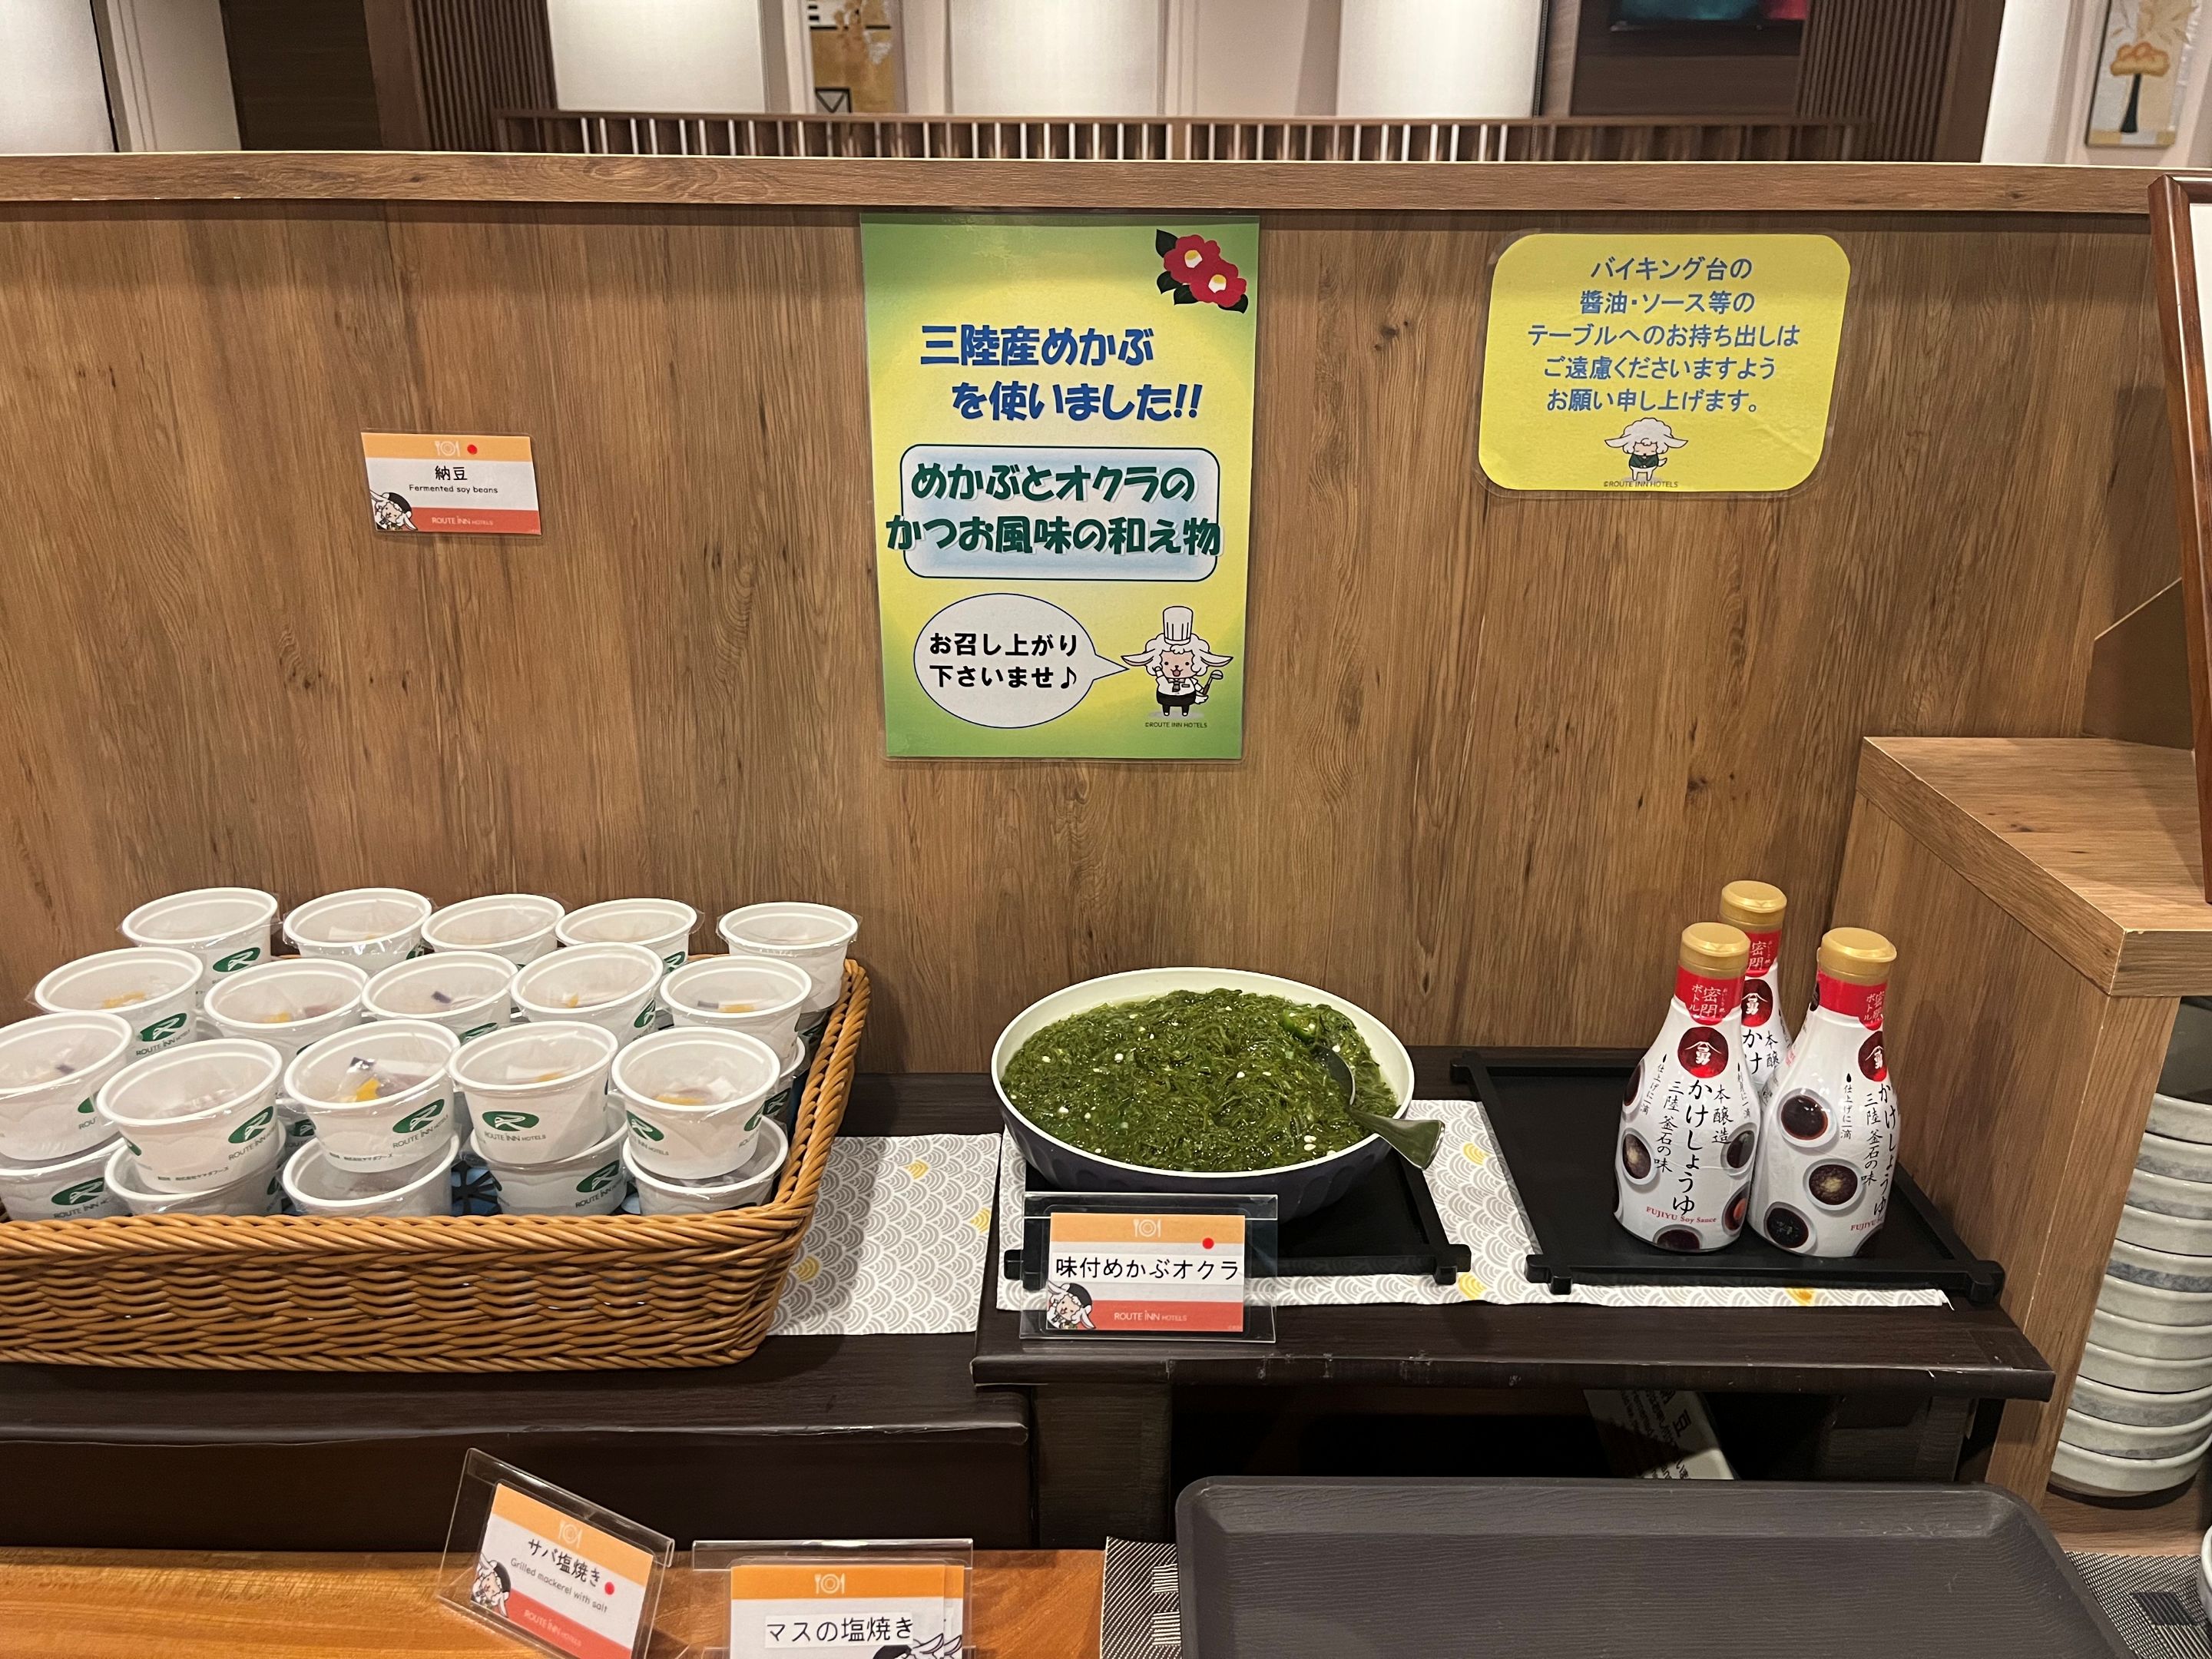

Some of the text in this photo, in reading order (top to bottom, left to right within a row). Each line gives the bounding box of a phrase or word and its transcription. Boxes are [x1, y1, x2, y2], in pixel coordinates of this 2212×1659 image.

[1591, 257, 1753, 281] バイキング台の
[920, 324, 1154, 366] 三陸産めかぶ
[1528, 324, 1800, 348] テーブルへのお持ち出しは
[1544, 356, 1776, 380] ご遠慮くださいますよう
[1548, 388, 1757, 413] お願い申し上げます。
[435, 465, 468, 481] 納豆
[911, 462, 1196, 503] めかぶとオクラの
[409, 484, 454, 492] Fermented
[886, 513, 1222, 557] かつお風味の和え物
[929, 633, 1078, 657] お召し上がり
[393, 1135, 419, 1148] ROUTE
[1673, 1079, 1712, 1216] かけしょうゆ
[575, 1194, 599, 1208] ROUTE
[1646, 1206, 1677, 1221] FUJIYU
[1680, 1216, 1694, 1224] Soy
[1055, 1257, 1238, 1280] 味付めかぶオクラ
[1114, 1312, 1142, 1321] ROUTE
[528, 1538, 601, 1588] サバ塩焼き
[511, 1558, 608, 1614] Grilled mackerel with salt
[767, 1617, 914, 1642] マスの塩焼き
